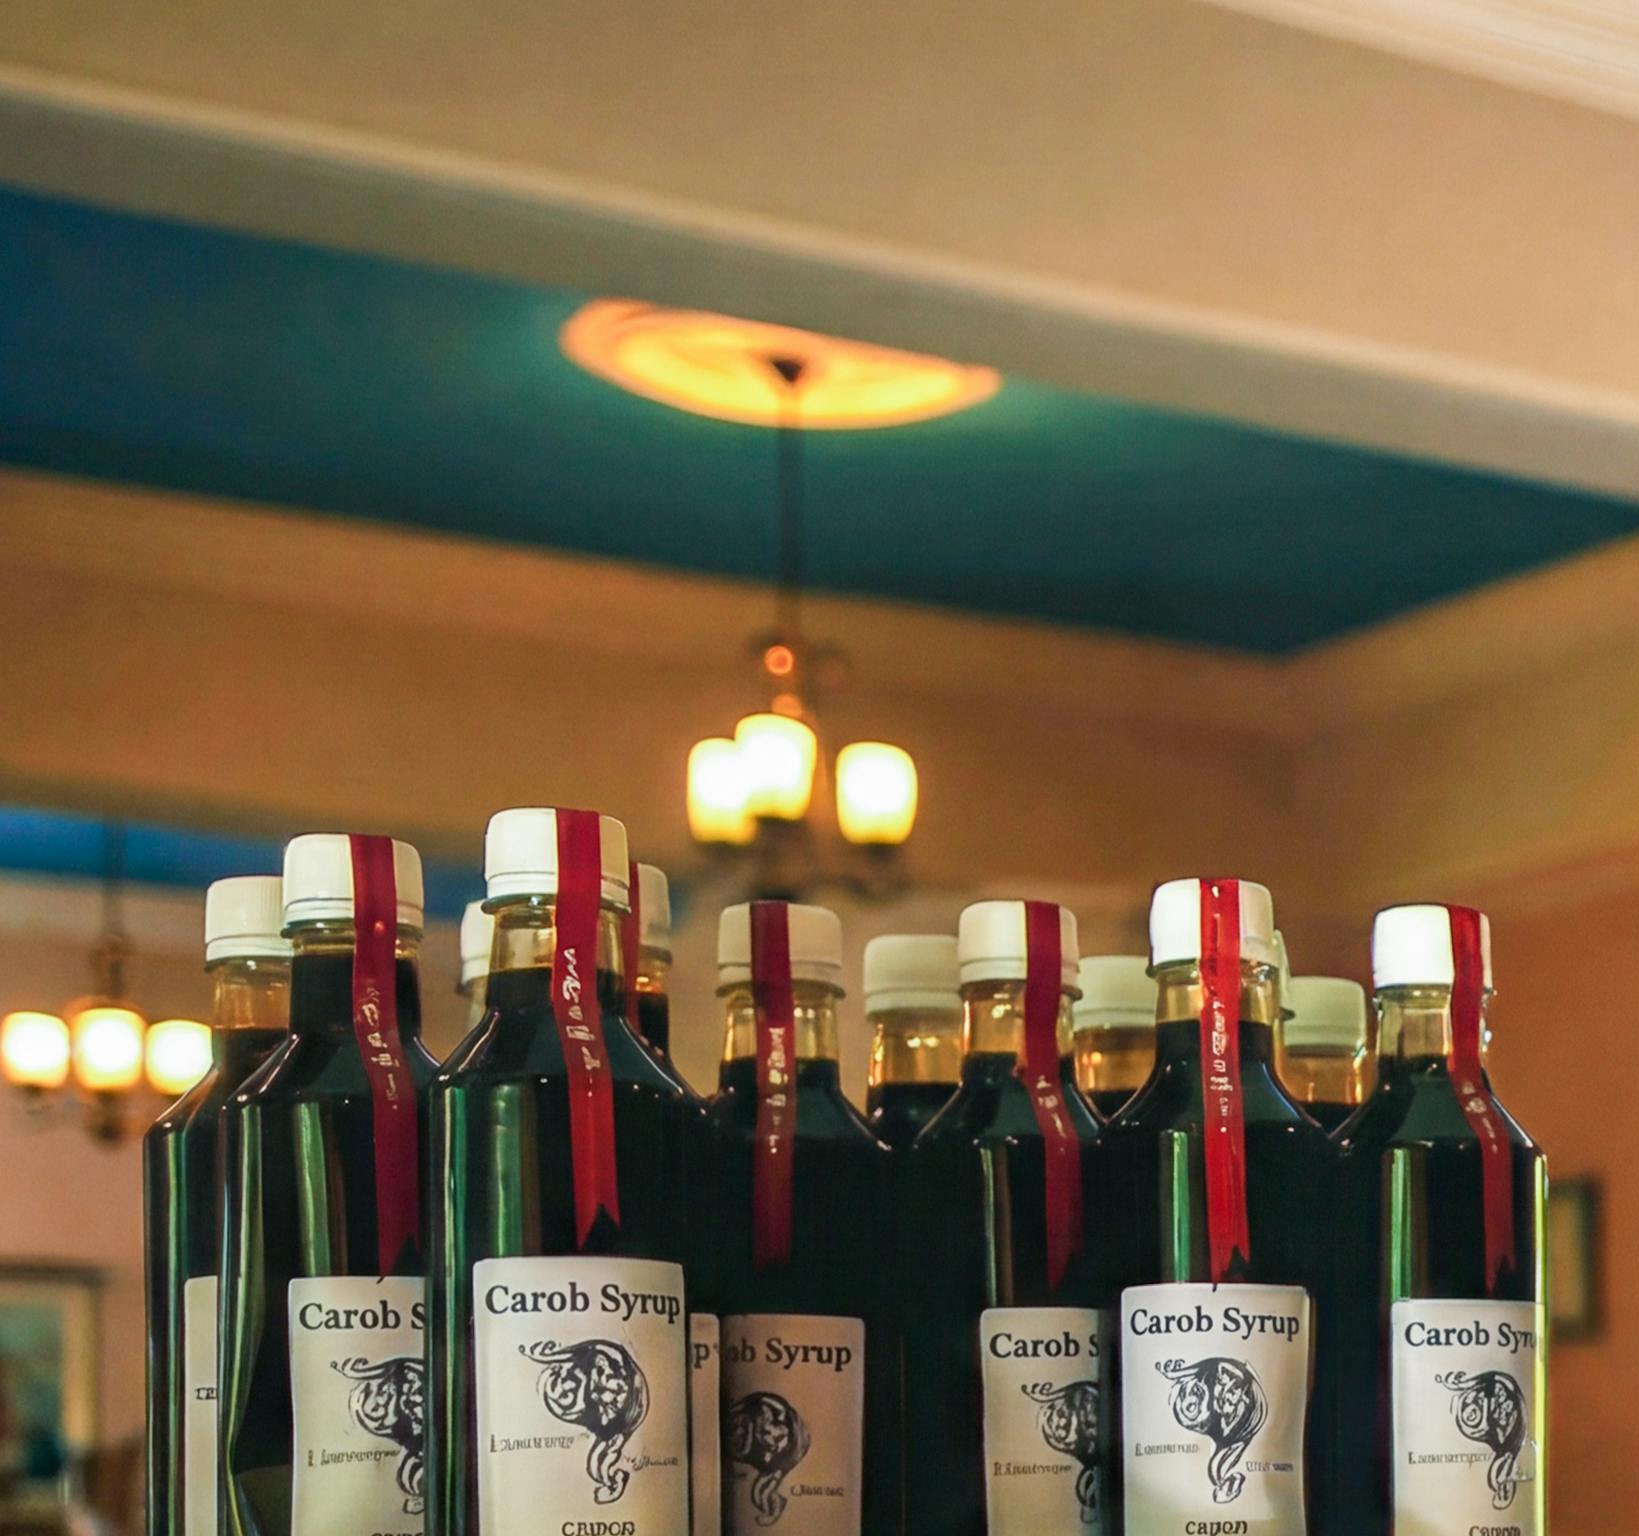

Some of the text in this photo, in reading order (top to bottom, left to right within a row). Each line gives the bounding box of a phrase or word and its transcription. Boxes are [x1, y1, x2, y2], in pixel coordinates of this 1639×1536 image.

[299, 1300, 401, 1331] Carob
[485, 1281, 682, 1326] Carob Syrup
[1130, 1305, 1300, 1342] Carob Syrup
[1405, 1320, 1490, 1348] Carob
[765, 1337, 852, 1373] Syrup
[989, 1331, 1081, 1359] Carob
